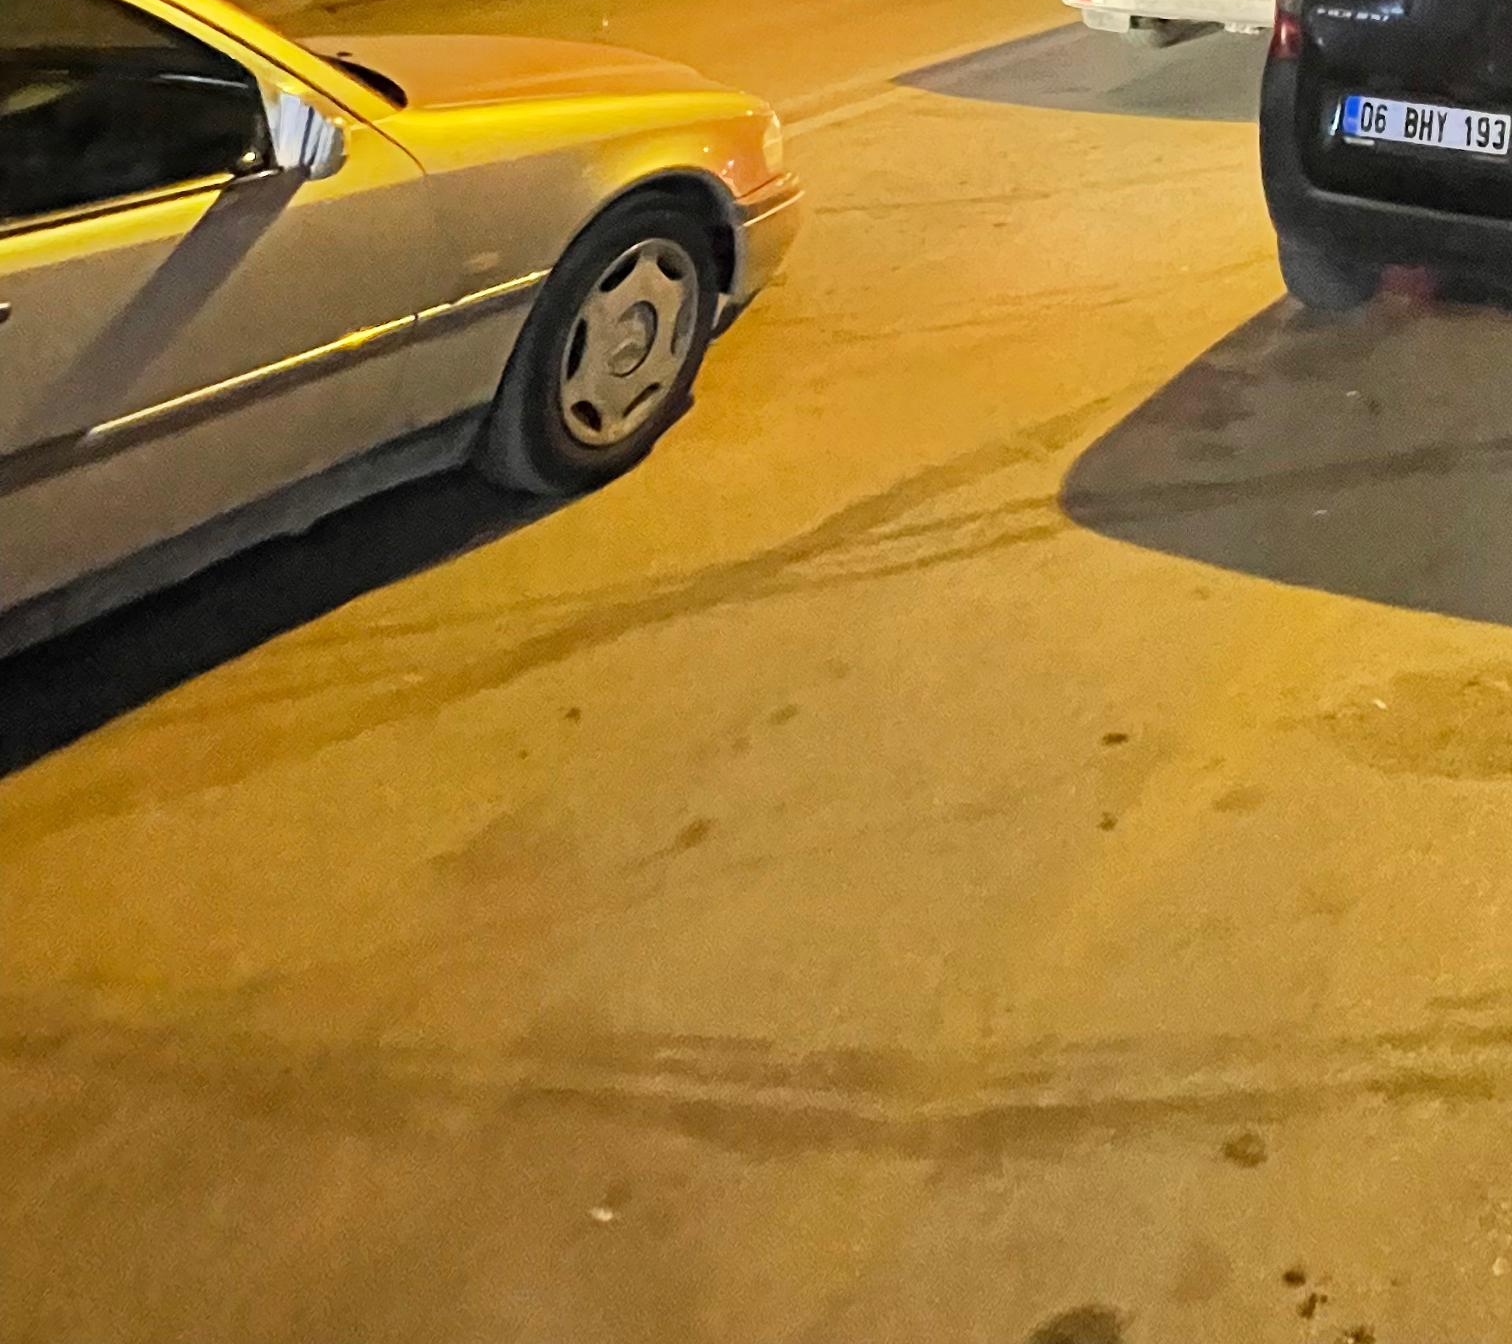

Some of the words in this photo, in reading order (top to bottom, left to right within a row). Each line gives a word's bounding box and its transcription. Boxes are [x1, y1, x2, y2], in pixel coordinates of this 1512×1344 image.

[1359, 101, 1388, 134] 06
[1403, 106, 1448, 144] BHY
[1463, 115, 1507, 151] 193
